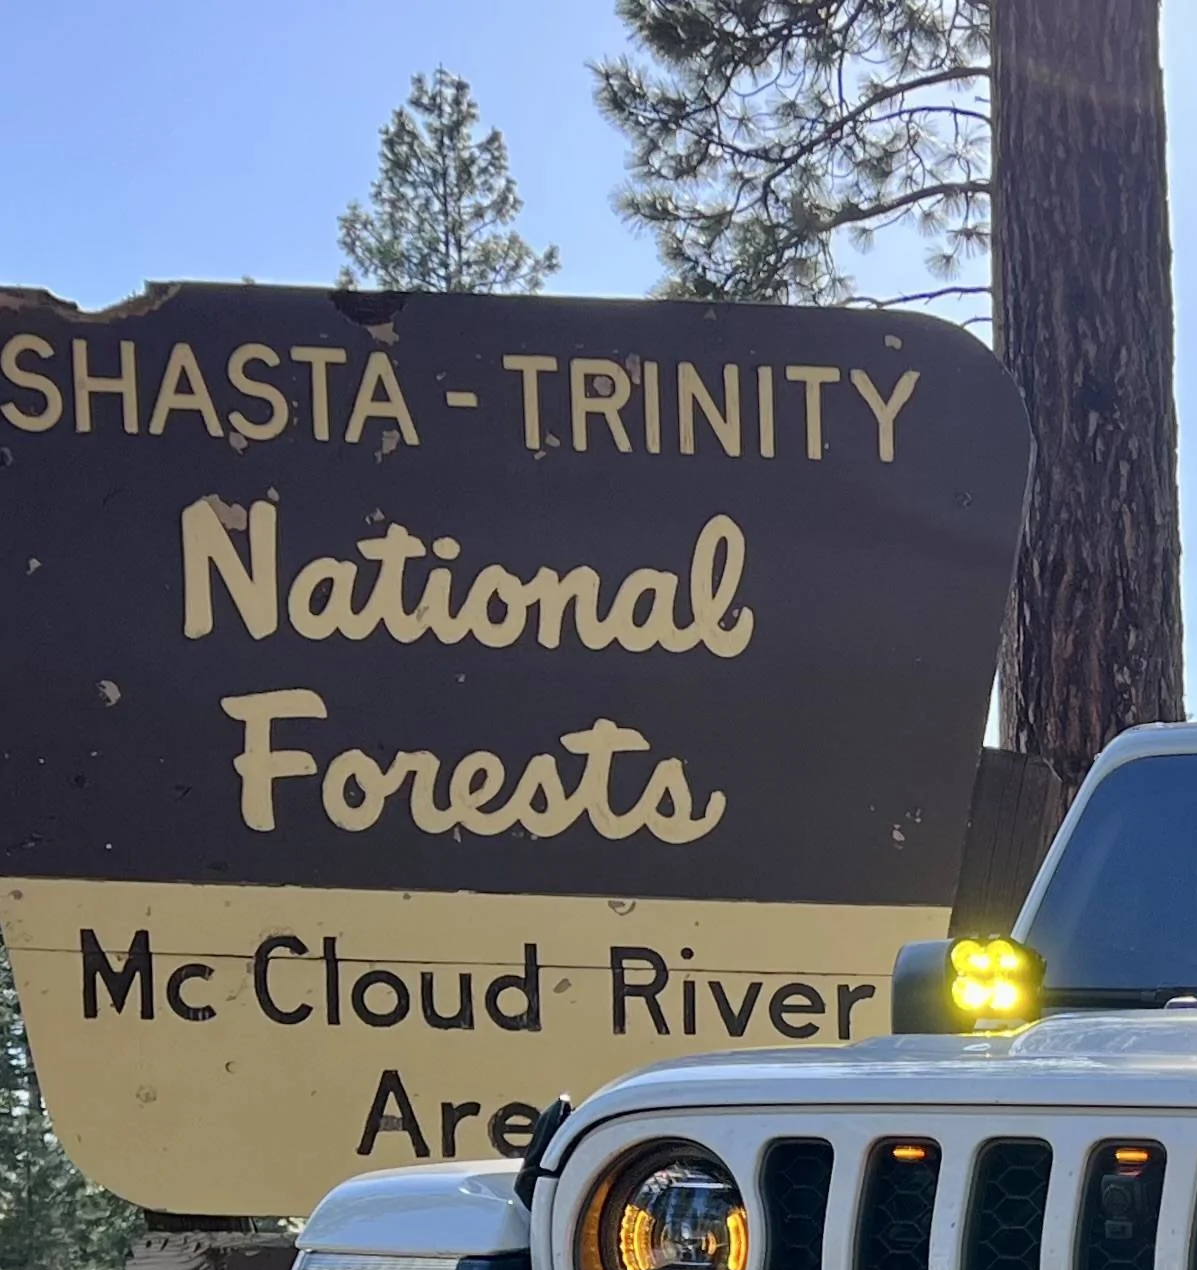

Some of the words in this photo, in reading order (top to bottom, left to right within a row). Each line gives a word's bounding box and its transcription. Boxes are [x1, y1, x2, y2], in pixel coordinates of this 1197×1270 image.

[0, 334, 419, 445] SHASTA
[502, 354, 921, 463] TRINITY
[181, 500, 755, 657] National
[221, 688, 728, 844] Forests
[608, 946, 875, 1040] River
[356, 1069, 540, 1158] Are
